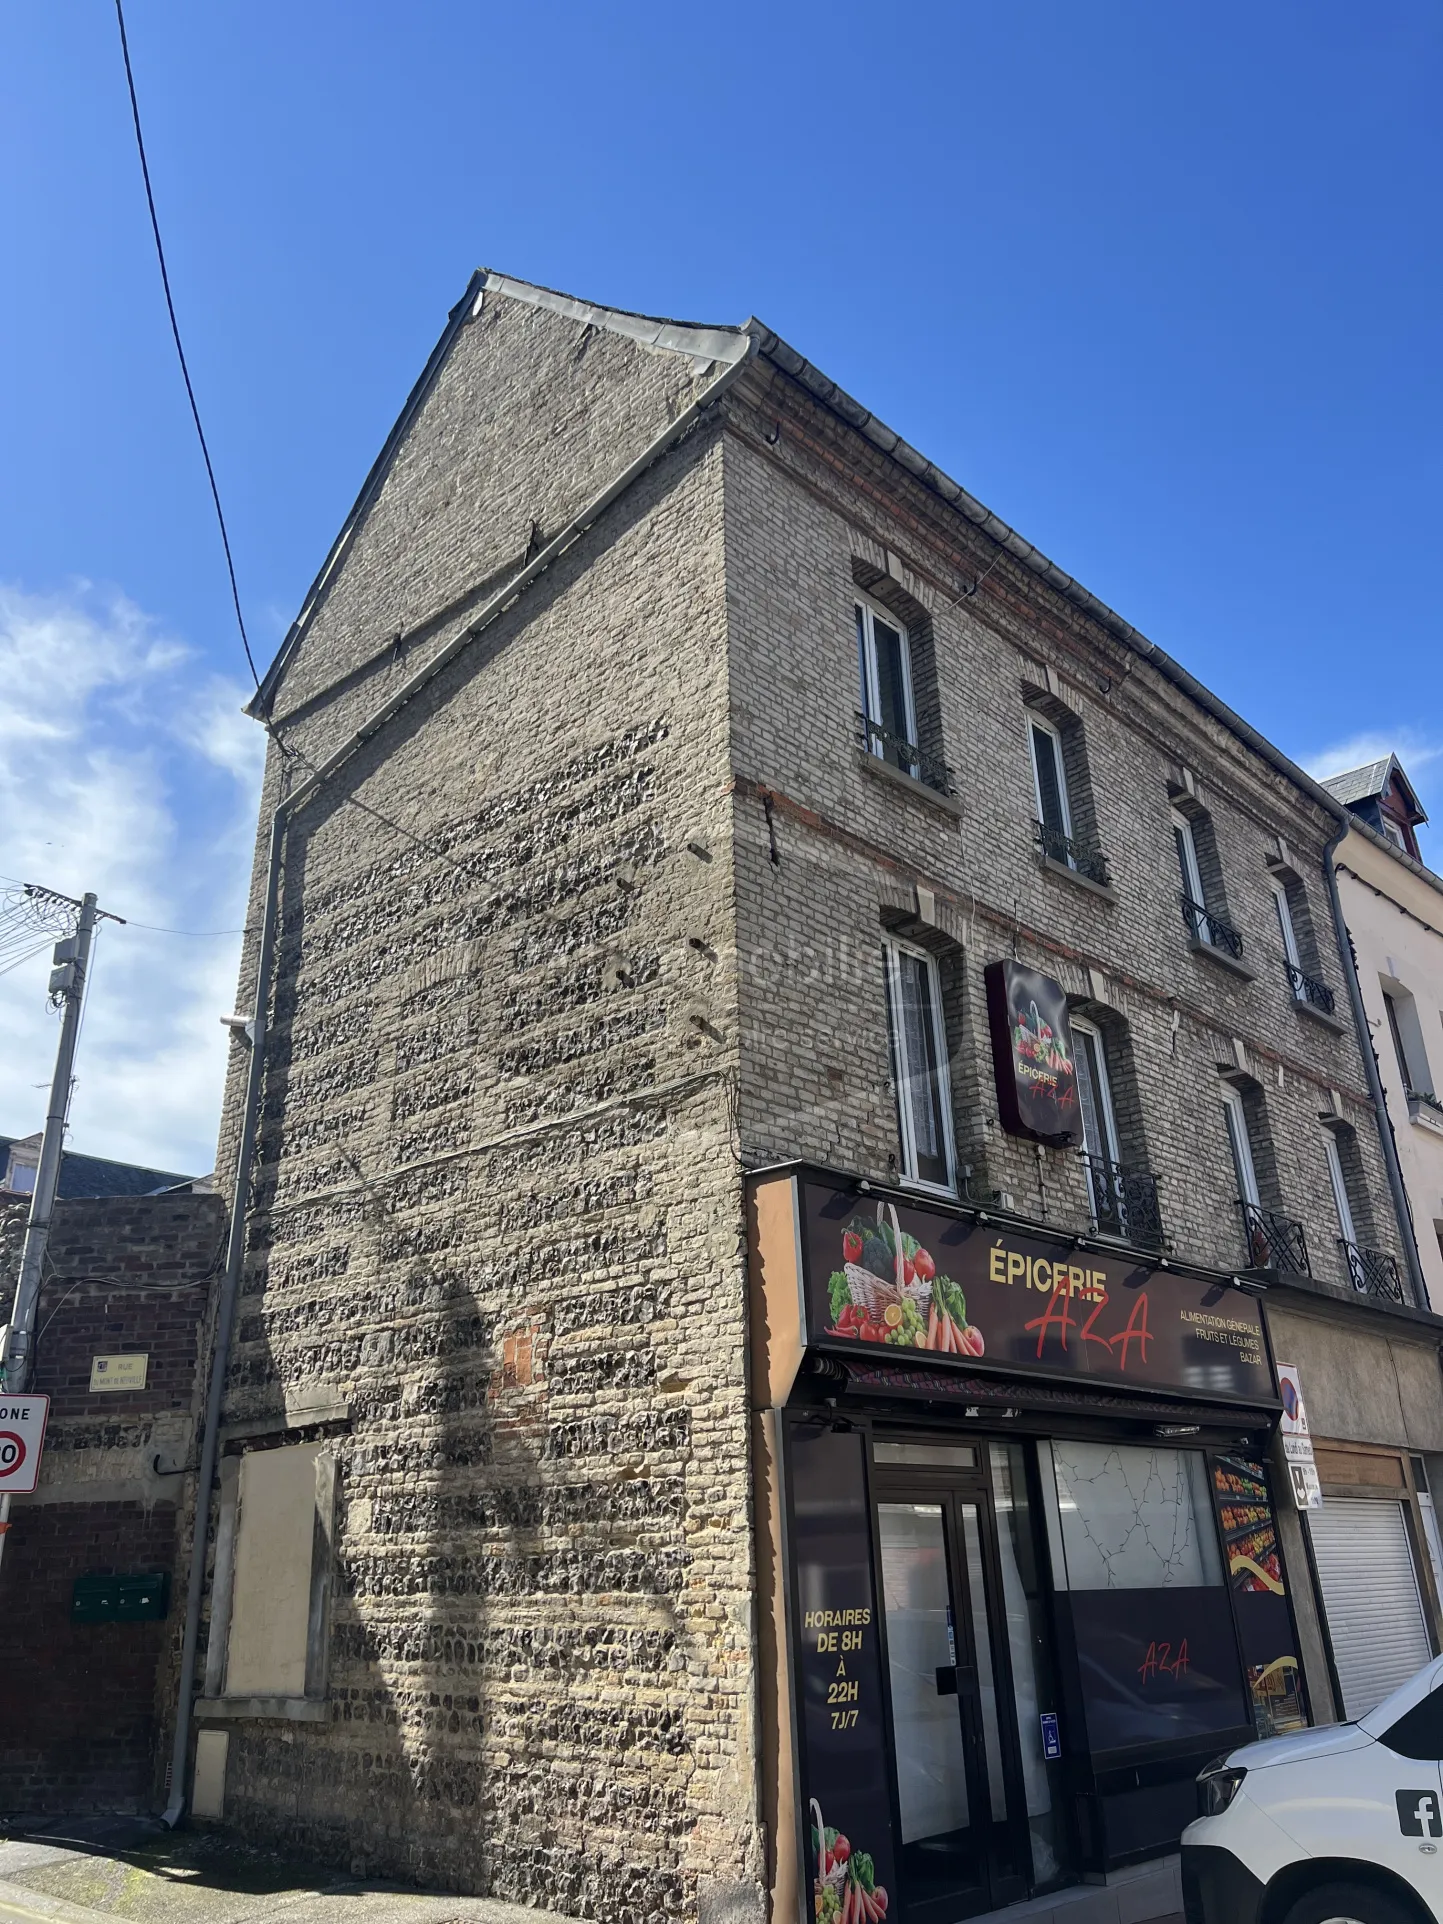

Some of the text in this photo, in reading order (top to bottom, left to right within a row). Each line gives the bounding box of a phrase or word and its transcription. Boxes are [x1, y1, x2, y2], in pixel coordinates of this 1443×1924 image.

[989, 1239, 1107, 1303] ÉPICERIE
[1180, 1309, 1227, 1329] ALIMENTATION
[1195, 1328, 1260, 1350] FRUITS ET LÉGUMES
[1239, 1351, 1262, 1365] BAZAR
[0, 1407, 31, 1420] ONE
[0, 1444, 17, 1463] 0
[804, 1608, 871, 1628] HORAIRES
[817, 1630, 862, 1653] DE 8H
[836, 1655, 846, 1677] À
[827, 1680, 859, 1704] 22H
[831, 1709, 859, 1730] 7J/7
